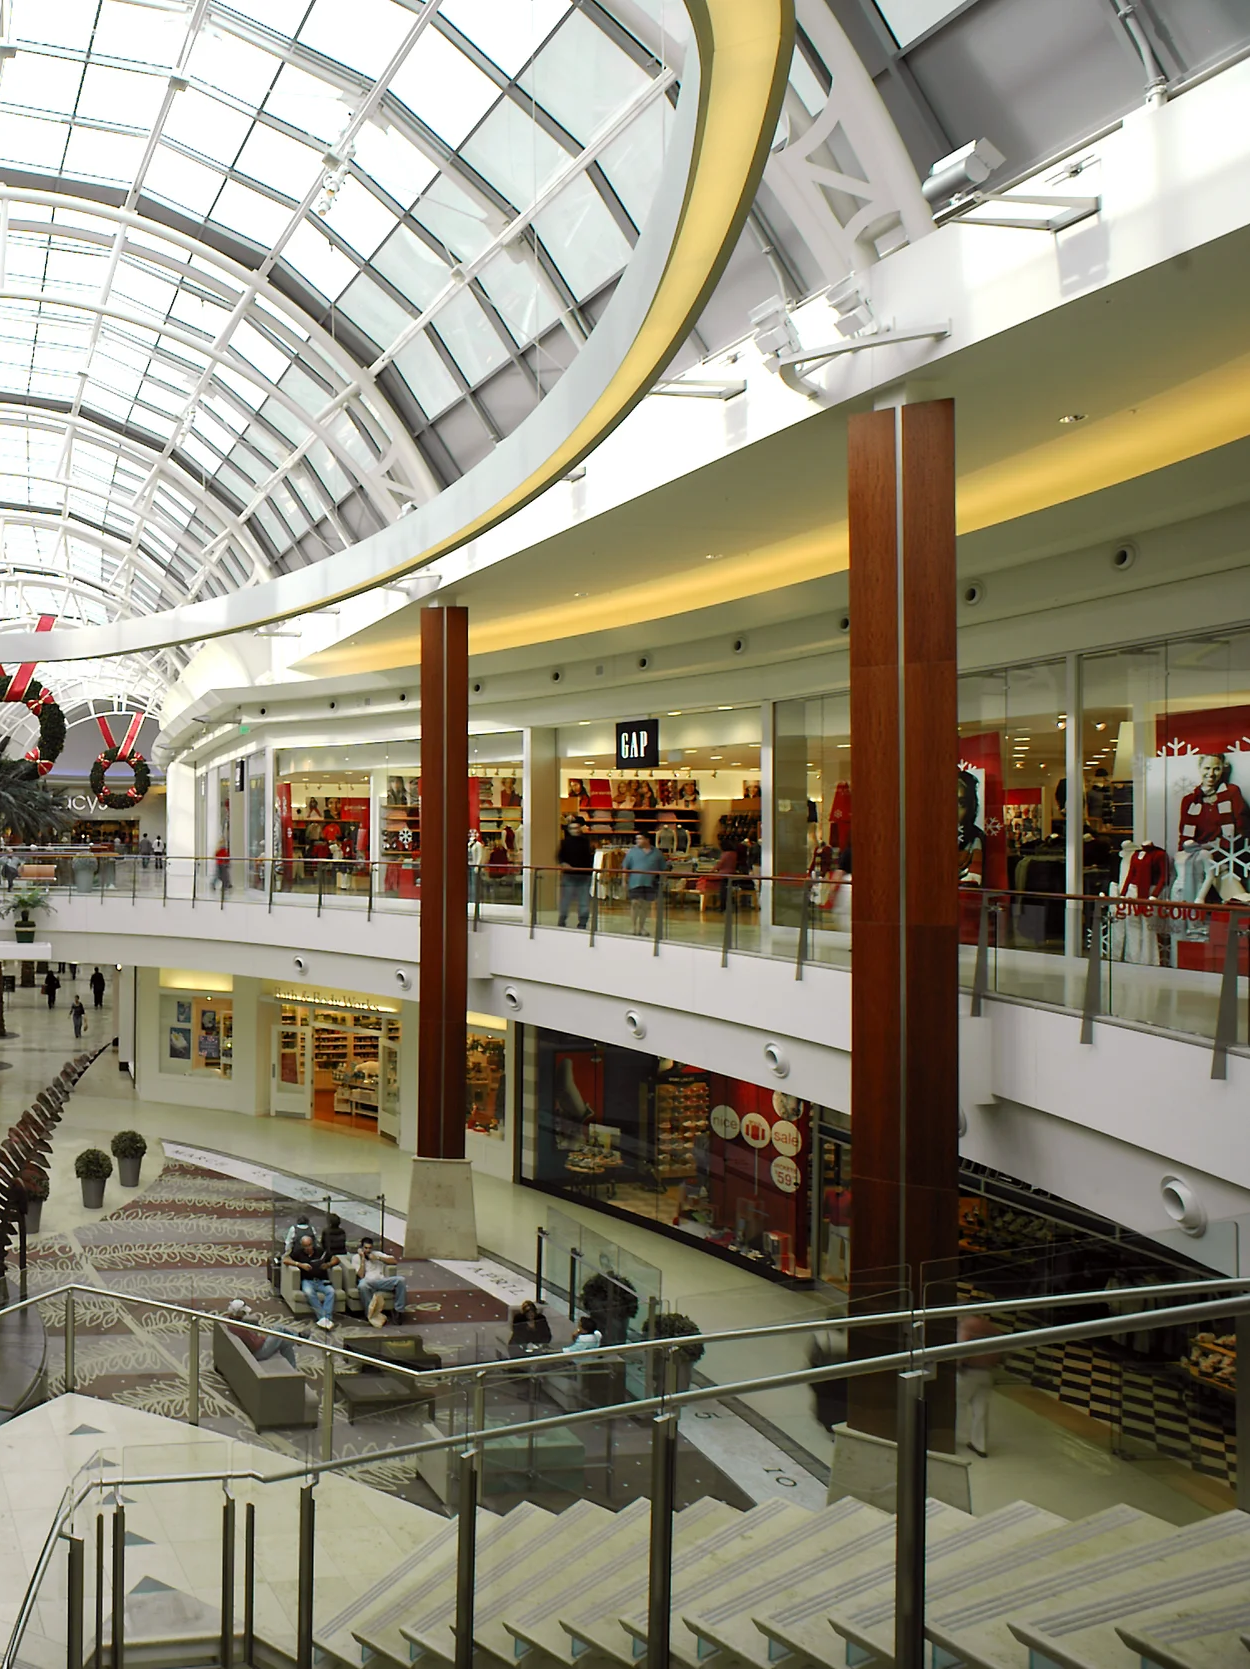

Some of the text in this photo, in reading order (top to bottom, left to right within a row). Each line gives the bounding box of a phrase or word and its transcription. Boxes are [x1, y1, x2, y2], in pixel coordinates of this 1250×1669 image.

[621, 730, 648, 759] GAP
[1115, 901, 1154, 920] give
[712, 1115, 737, 1130] nice
[773, 1130, 799, 1148] sale
[466, 1266, 525, 1296] APRIL
